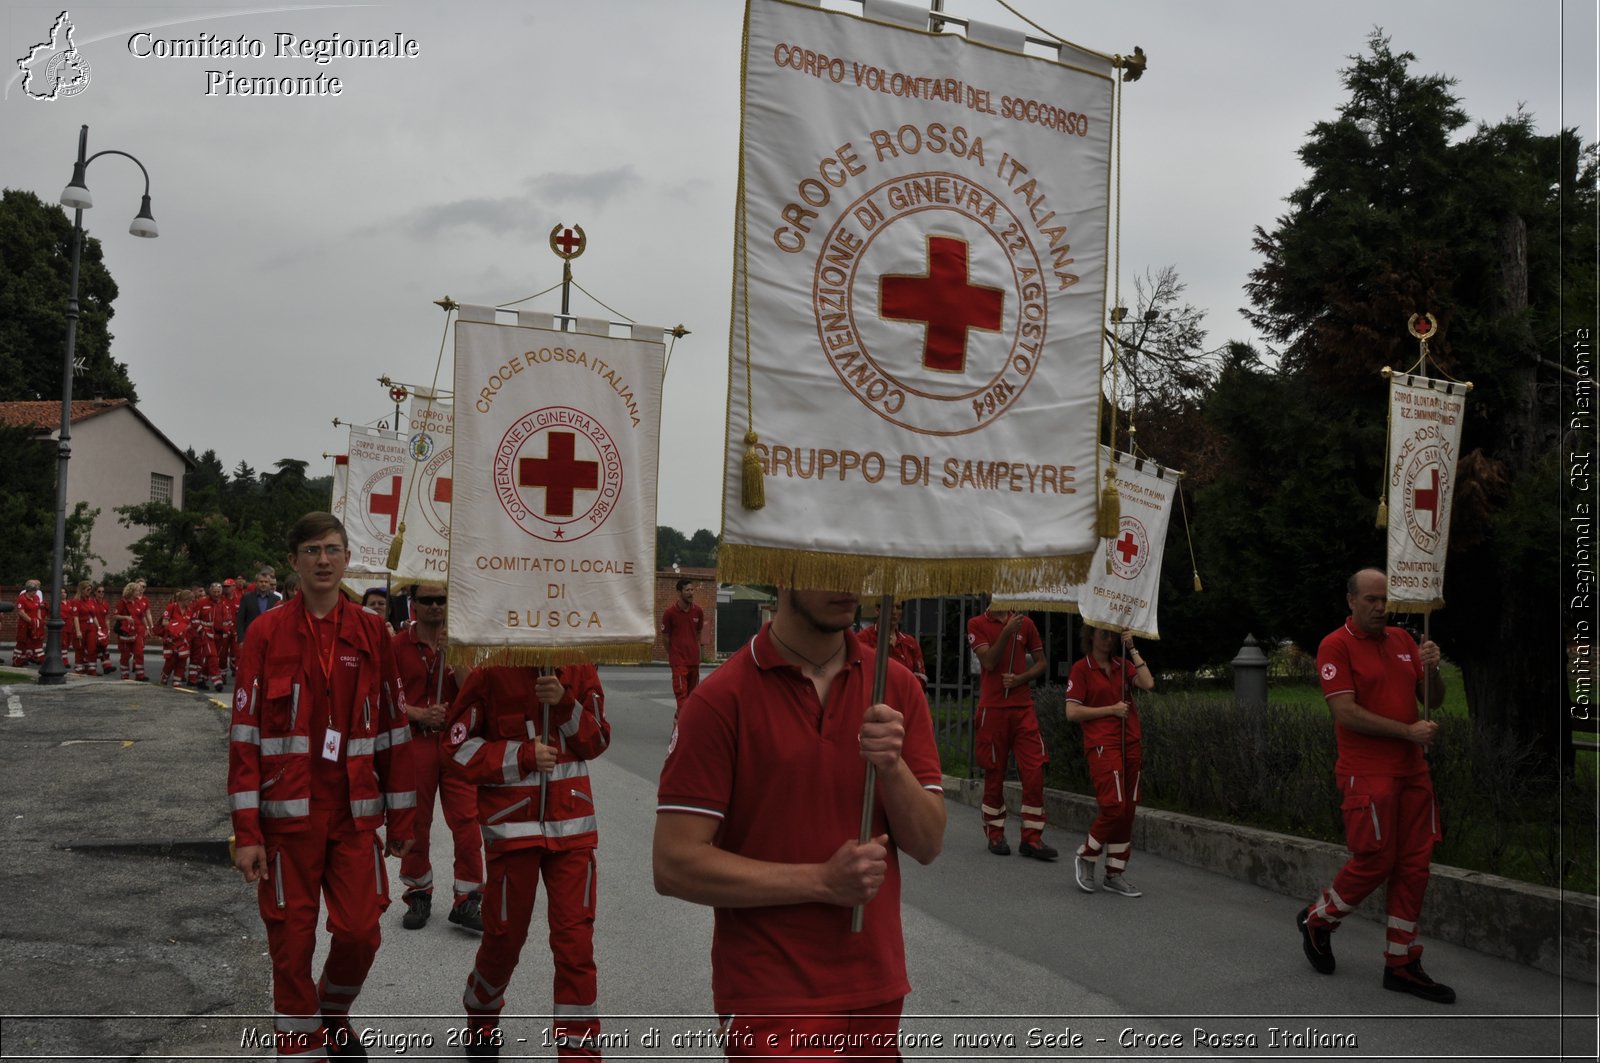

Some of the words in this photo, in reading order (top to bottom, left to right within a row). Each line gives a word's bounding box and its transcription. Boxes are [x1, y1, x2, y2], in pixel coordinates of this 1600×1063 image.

[774, 43, 845, 84] CORPO
[853, 61, 963, 104] VOLONTARI
[967, 85, 997, 116] DEL
[1001, 95, 1089, 138] SOCCORSO
[773, 141, 868, 254] CROCE
[870, 122, 986, 168] ROSSA
[997, 152, 1081, 292] ITALIANA
[853, 198, 886, 232] DI
[887, 177, 998, 226] GINEVRA
[1000, 222, 1028, 258] 22
[818, 227, 907, 416] CONVENZIONE
[1013, 265, 1044, 377] AGOSTO
[475, 356, 526, 415] CROCE
[524, 346, 589, 370] ROSSA
[591, 357, 642, 429] ITALIANA
[972, 377, 1017, 422] 1864
[411, 420, 453, 435] CROCE
[520, 417, 536, 433] DI
[536, 411, 592, 435] GINEVRA
[590, 426, 606, 444] 22
[351, 449, 380, 462] CROCE
[600, 443, 620, 499] AGOSTO
[497, 427, 526, 522] CONVENZIONE
[901, 454, 930, 486] DI
[942, 456, 1078, 495] SAMPEYRE
[588, 499, 610, 525] 1864
[476, 555, 566, 574] COMITATO
[571, 558, 635, 576] LOCALE
[1391, 574, 1420, 588] BORGO
[547, 582, 566, 600] DI
[507, 609, 603, 629] BUSCA
